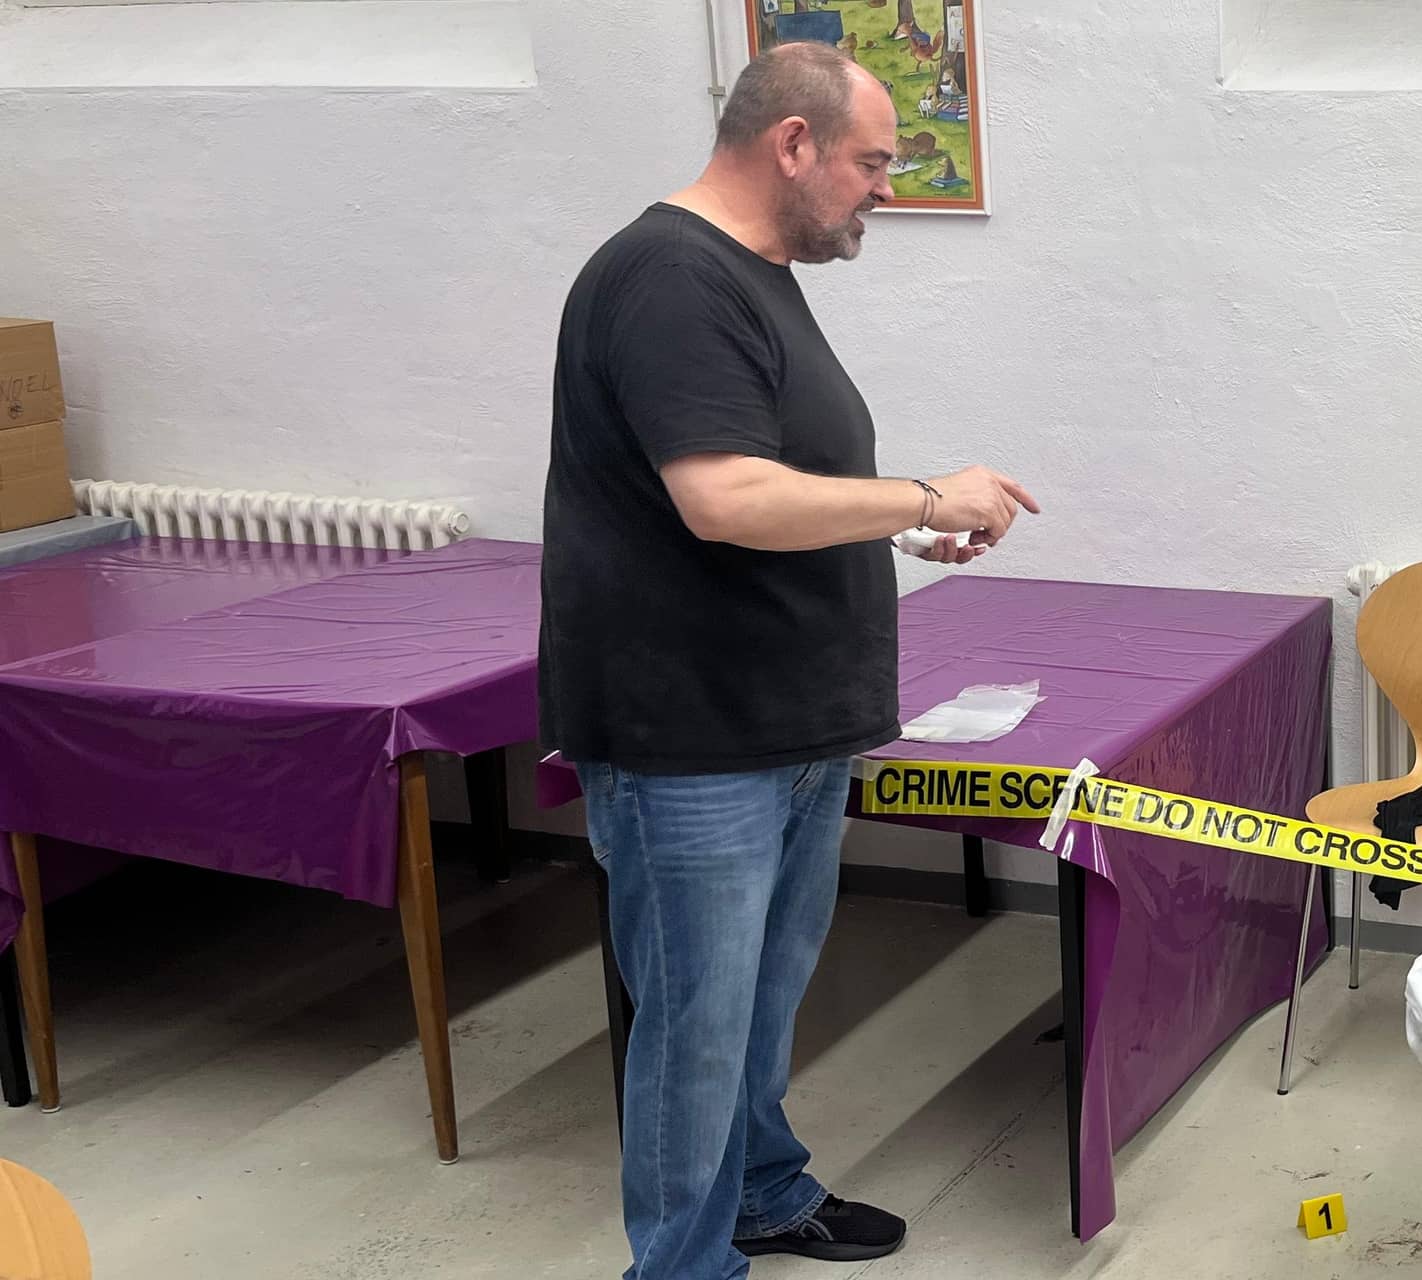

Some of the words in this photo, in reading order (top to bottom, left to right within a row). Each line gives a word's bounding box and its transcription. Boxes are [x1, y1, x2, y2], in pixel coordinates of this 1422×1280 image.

[875, 768, 991, 806] CRIME
[1133, 791, 1194, 830] DO
[1202, 806, 1287, 846] NOT
[1318, 1202, 1332, 1230] 1
